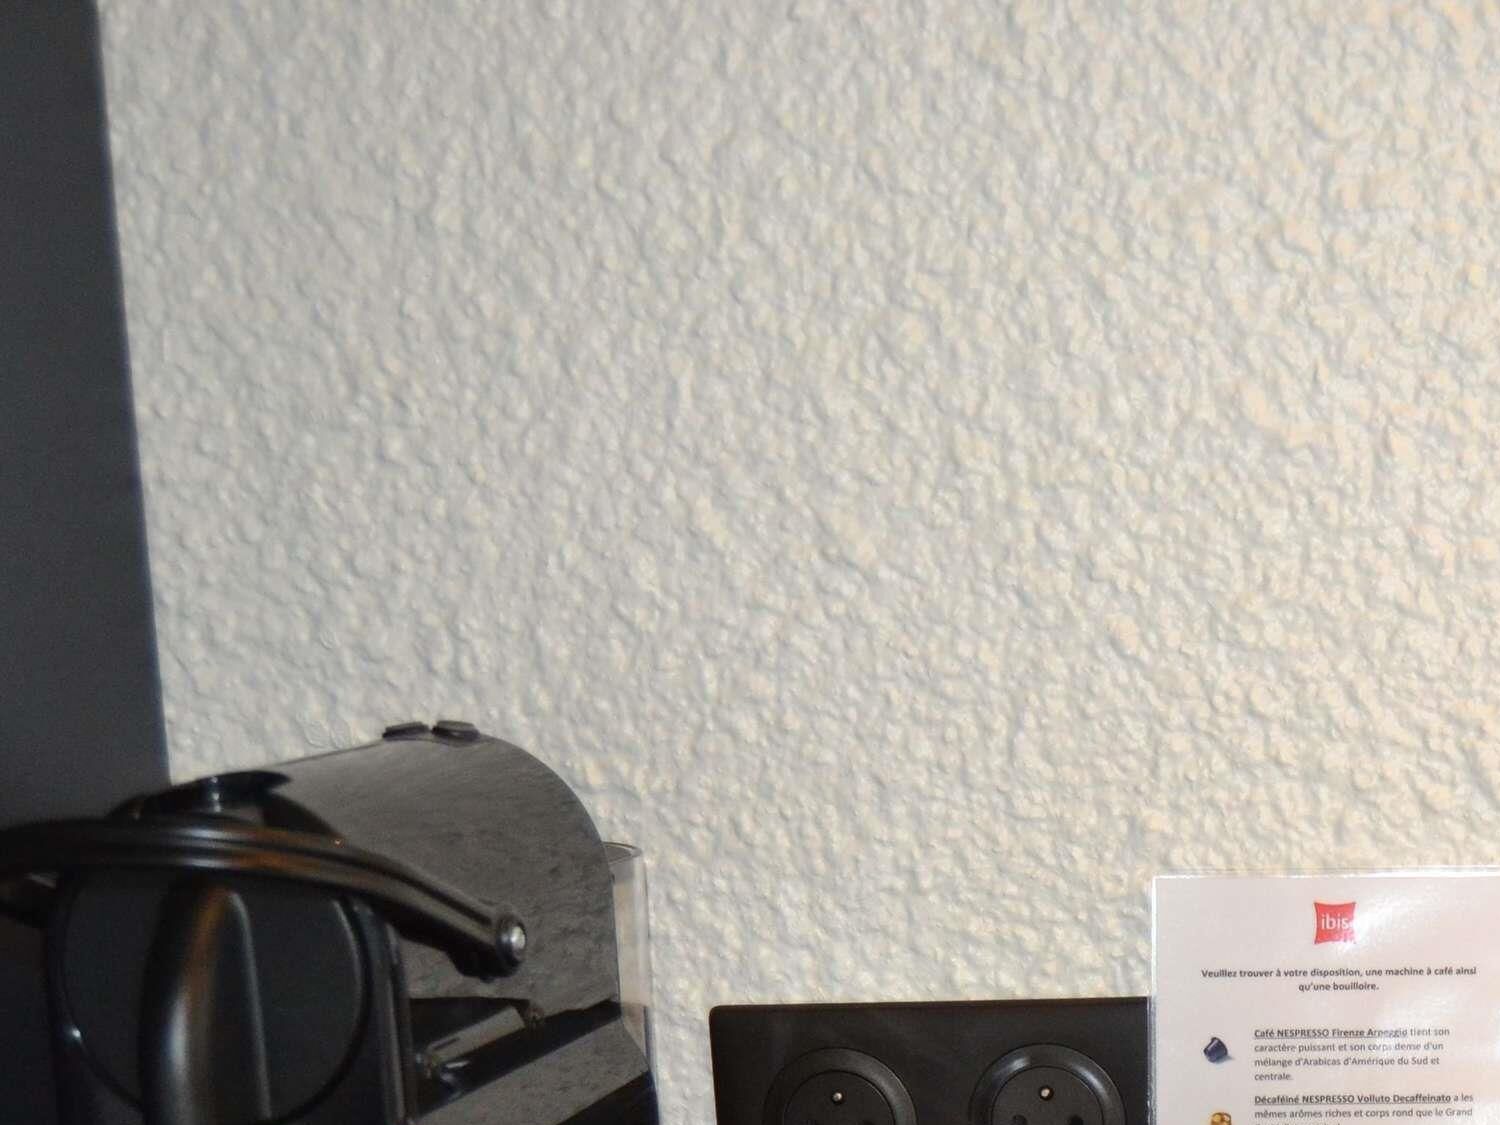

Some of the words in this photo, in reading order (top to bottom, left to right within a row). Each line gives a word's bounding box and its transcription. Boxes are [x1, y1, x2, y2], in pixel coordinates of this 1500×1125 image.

[1321, 912, 1350, 931] ibis
[1201, 968, 1237, 978] Veuillez
[1239, 968, 1274, 978] trouver
[1276, 968, 1281, 977] à
[1283, 968, 1308, 978] votre
[1310, 967, 1363, 979] disposition,
[1365, 968, 1383, 977] une
[1385, 966, 1424, 976] machine
[1427, 966, 1432, 976] à
[1434, 966, 1454, 976] café
[1455, 966, 1477, 976] ainsi
[1298, 982, 1331, 992] qu'une
[1332, 981, 1380, 991] bouilloire.
[1254, 1028, 1275, 1039] Café
[1277, 1028, 1329, 1039] NESPRESSO
[1331, 1028, 1365, 1039] Firenze
[1298, 1043, 1336, 1053] puissant
[1338, 1043, 1347, 1052] et
[1349, 1043, 1366, 1052] son
[1254, 1058, 1293, 1068] mélange
[1397, 1057, 1409, 1066] du
[1411, 1057, 1428, 1066] Sud
[1430, 1057, 1440, 1066] et
[1302, 1094, 1355, 1105] NESPRESSO
[1357, 1093, 1391, 1105] Volluto
[1254, 1109, 1287, 1119] mêmes
[1325, 1108, 1352, 1118] riches
[1354, 1109, 1364, 1118] et
[1365, 1109, 1390, 1119] corps
[1392, 1108, 1414, 1117] rond
[1416, 1109, 1433, 1119] que
[1445, 1107, 1473, 1117] Grand
